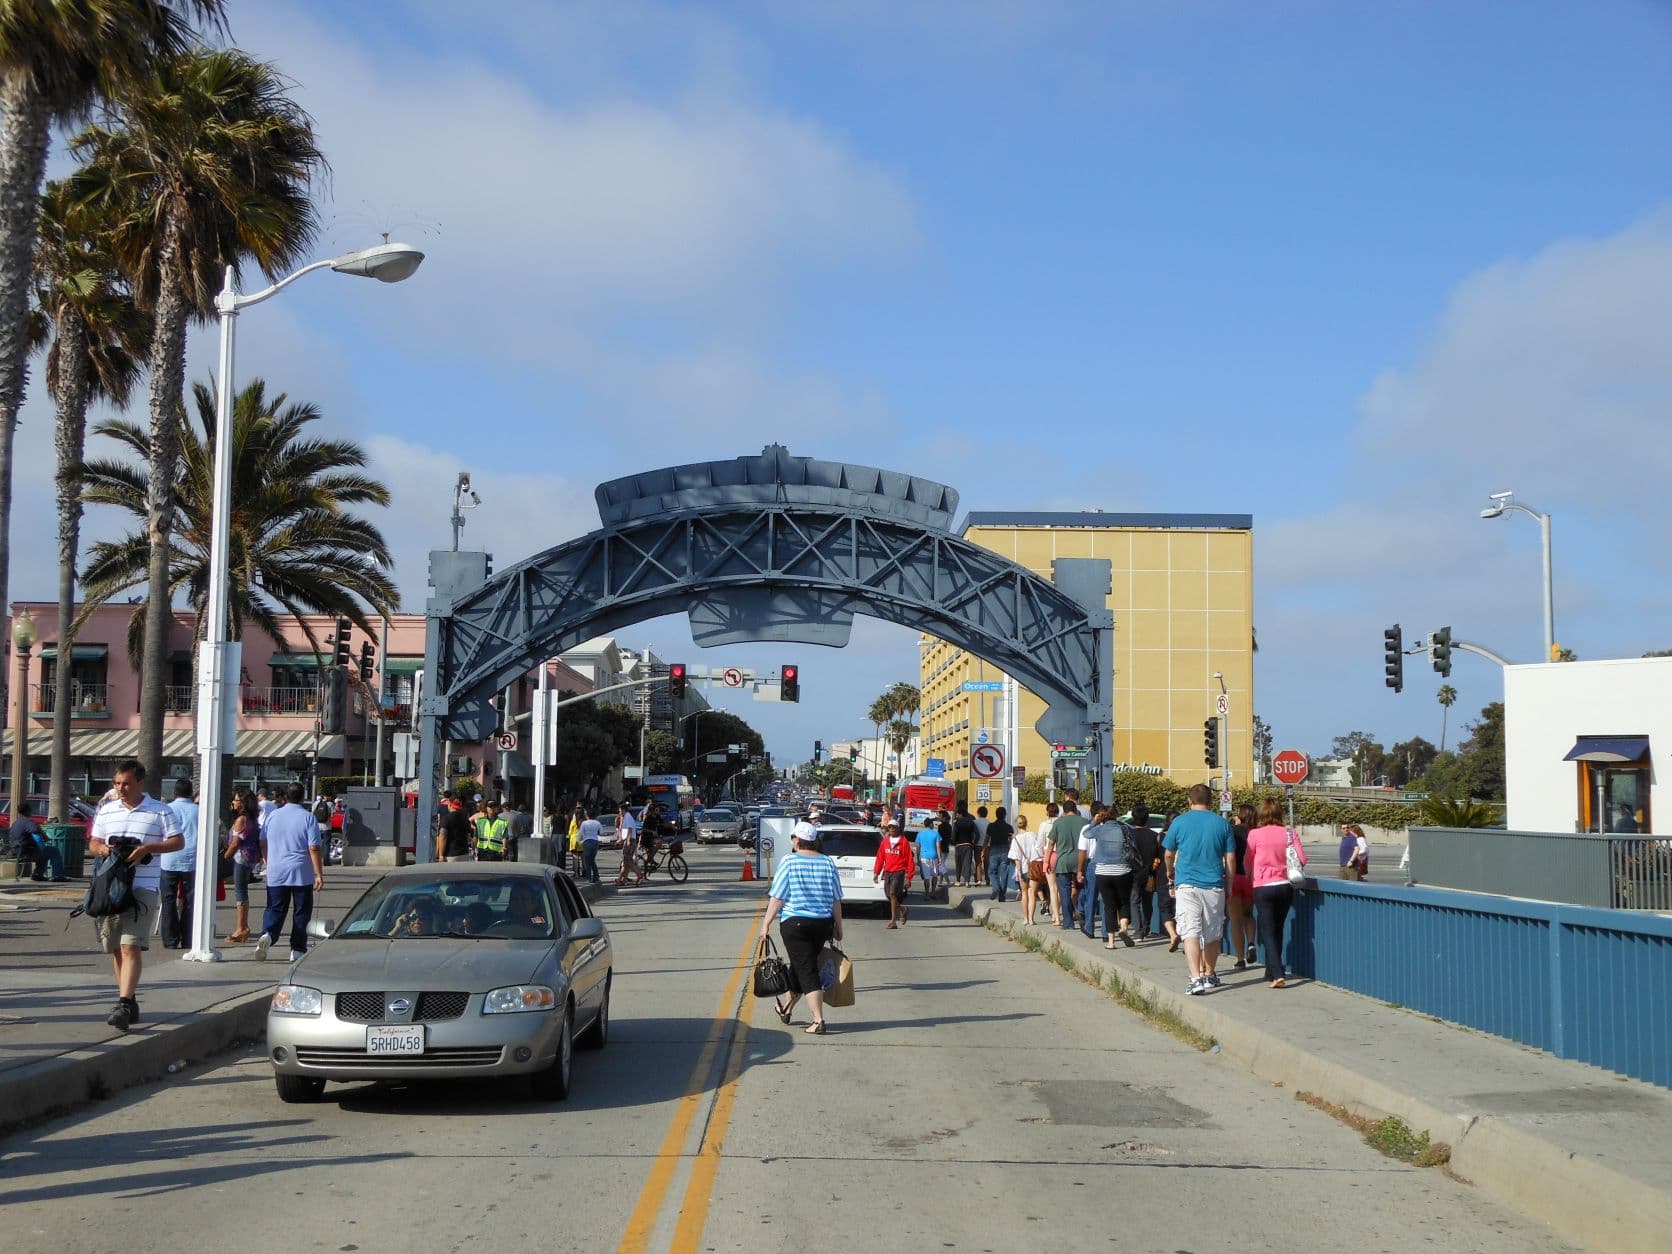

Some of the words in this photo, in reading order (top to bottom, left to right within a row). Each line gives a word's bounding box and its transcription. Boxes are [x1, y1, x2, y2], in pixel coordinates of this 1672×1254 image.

[964, 682, 988, 690] Ocean
[1141, 761, 1160, 774] Inn
[1275, 760, 1305, 774] STOP
[371, 1036, 420, 1051] 5RHD458
